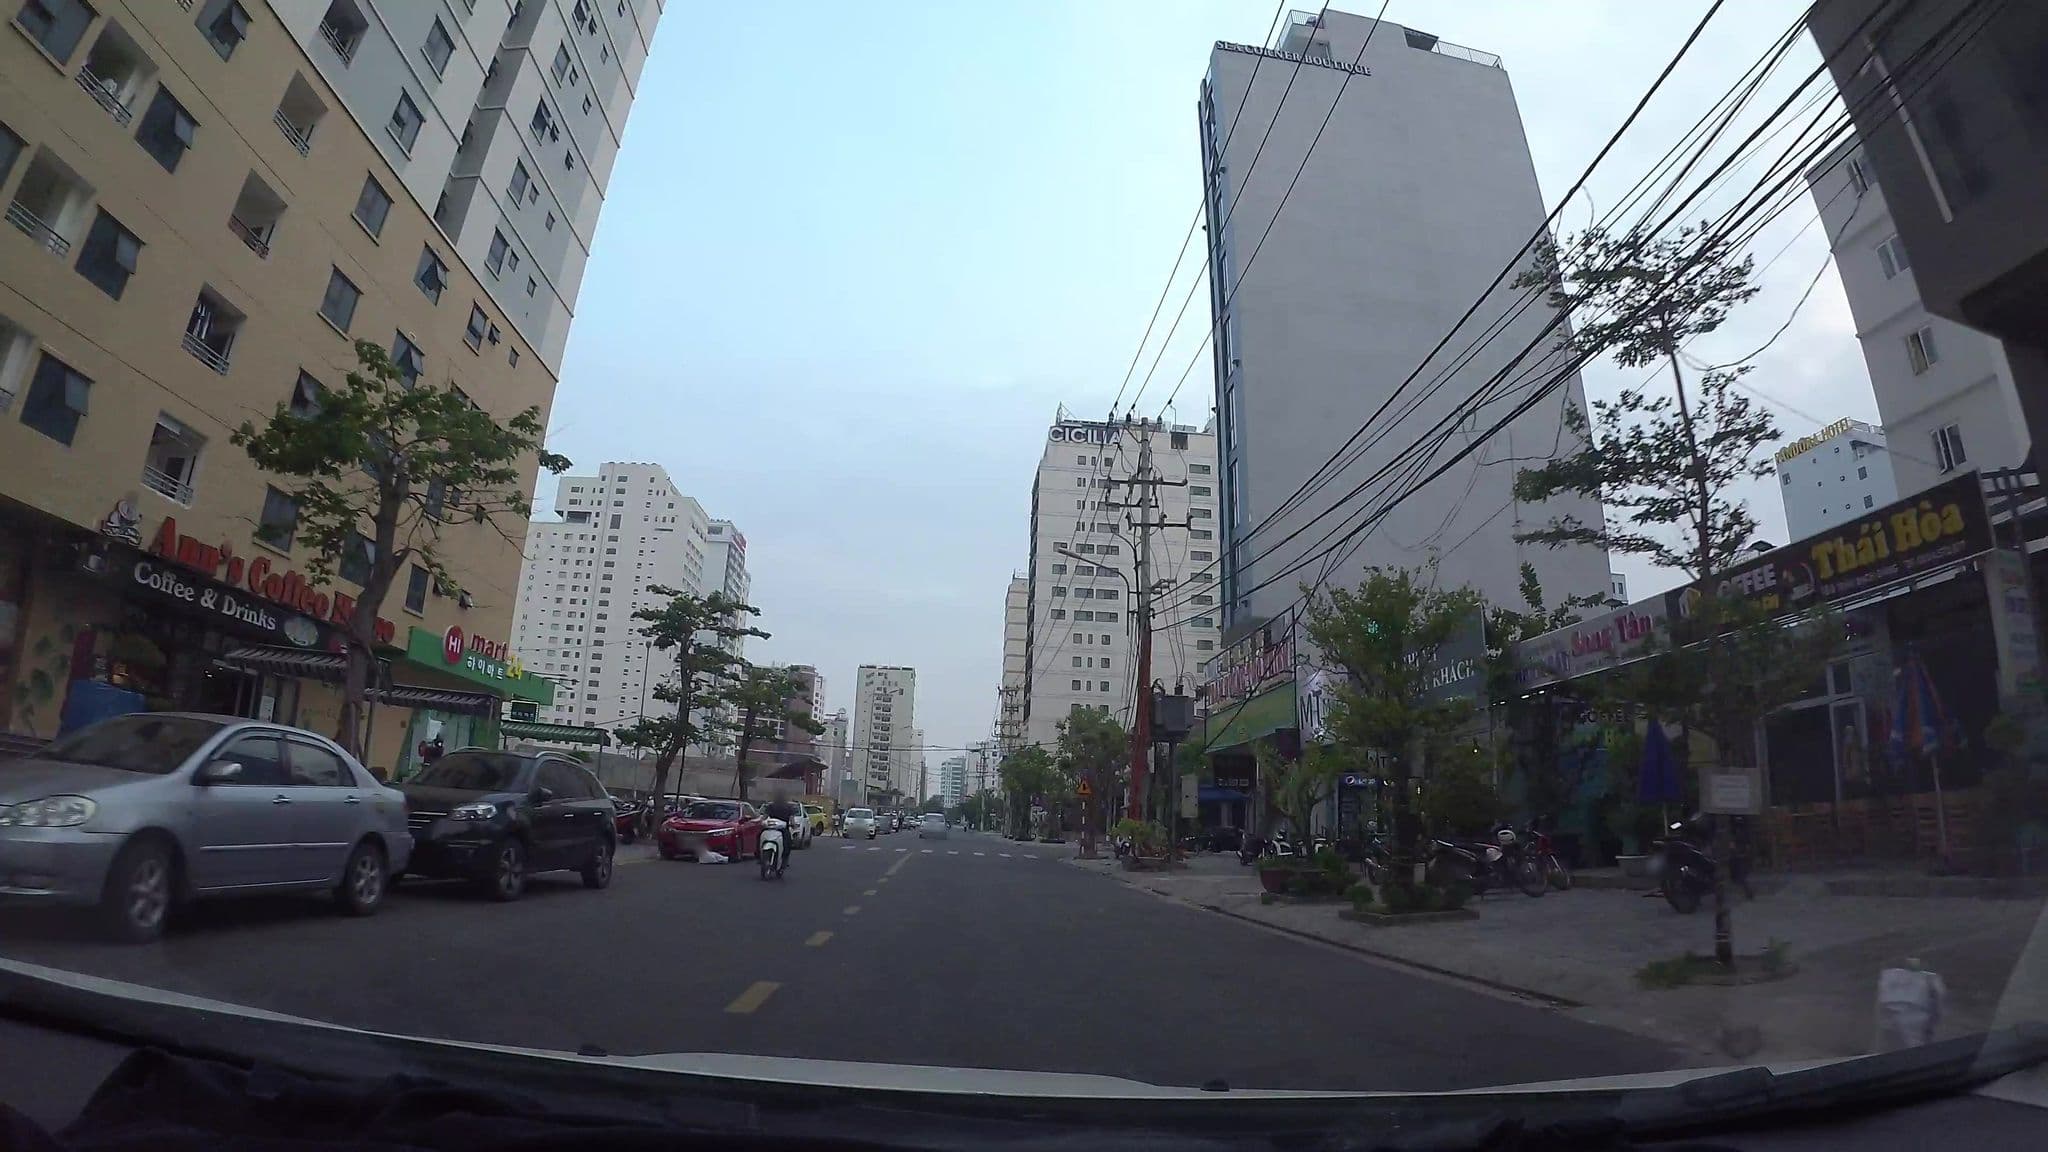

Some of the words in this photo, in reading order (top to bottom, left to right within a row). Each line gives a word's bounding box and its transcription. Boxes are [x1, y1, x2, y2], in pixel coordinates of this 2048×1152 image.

[1050, 426, 1122, 445] CICILIA
[1811, 521, 1890, 580] Thái
[1889, 499, 1965, 553] Hòa
[134, 561, 194, 602] Coffee
[200, 588, 218, 610] &
[221, 594, 277, 631] Drinks
[249, 555, 330, 617] Coffee
[448, 635, 462, 654] HI
[470, 632, 509, 663] mart
